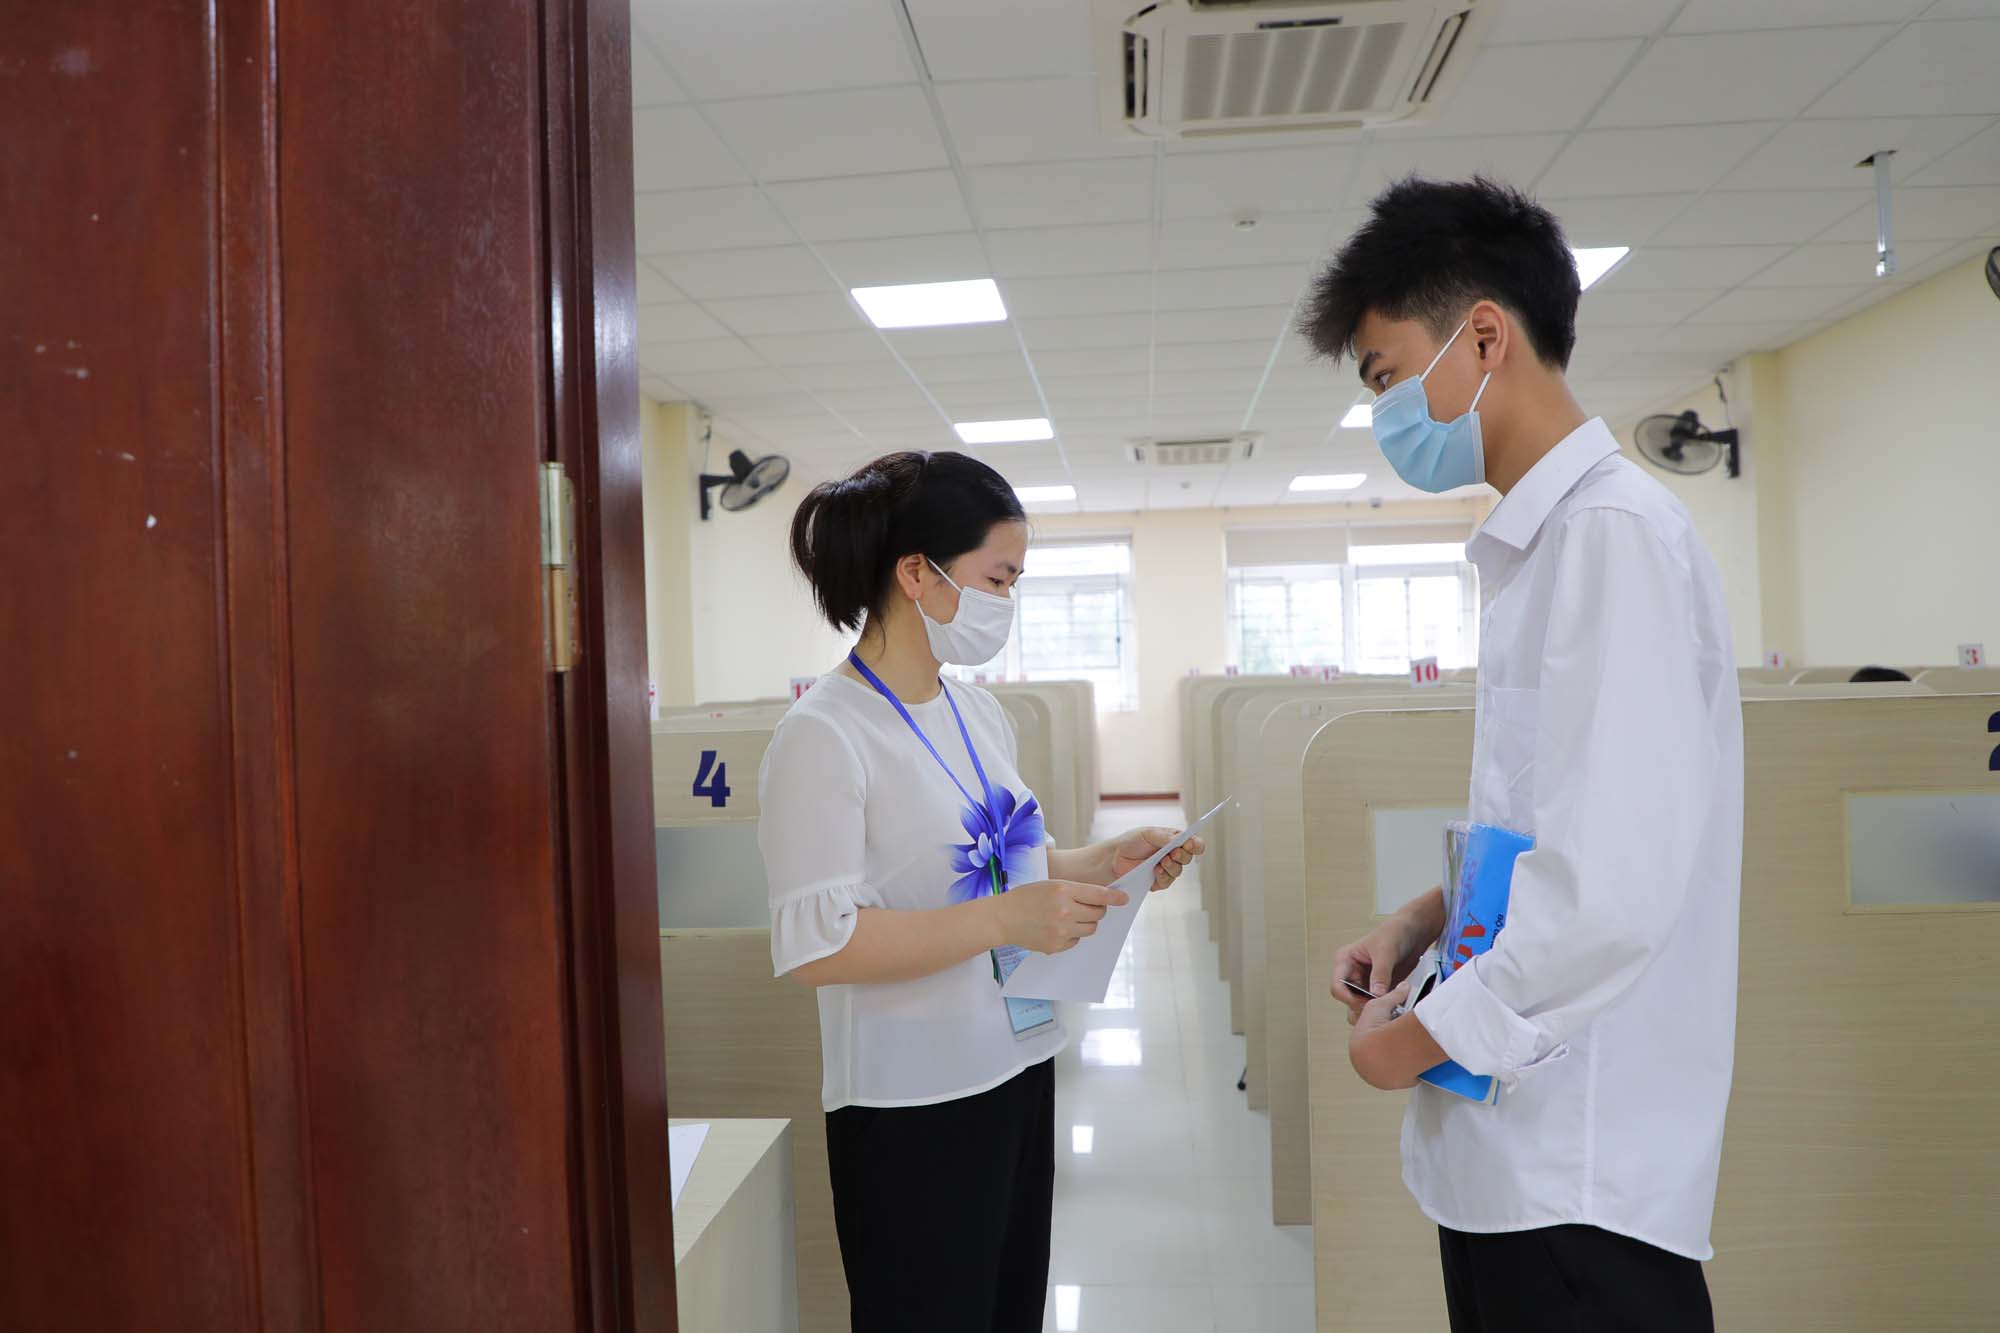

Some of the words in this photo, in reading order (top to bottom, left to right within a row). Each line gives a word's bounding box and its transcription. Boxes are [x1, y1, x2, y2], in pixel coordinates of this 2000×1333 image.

[1966, 648, 1979, 665] 3
[1413, 662, 1439, 683] 10
[692, 750, 731, 807] 4
